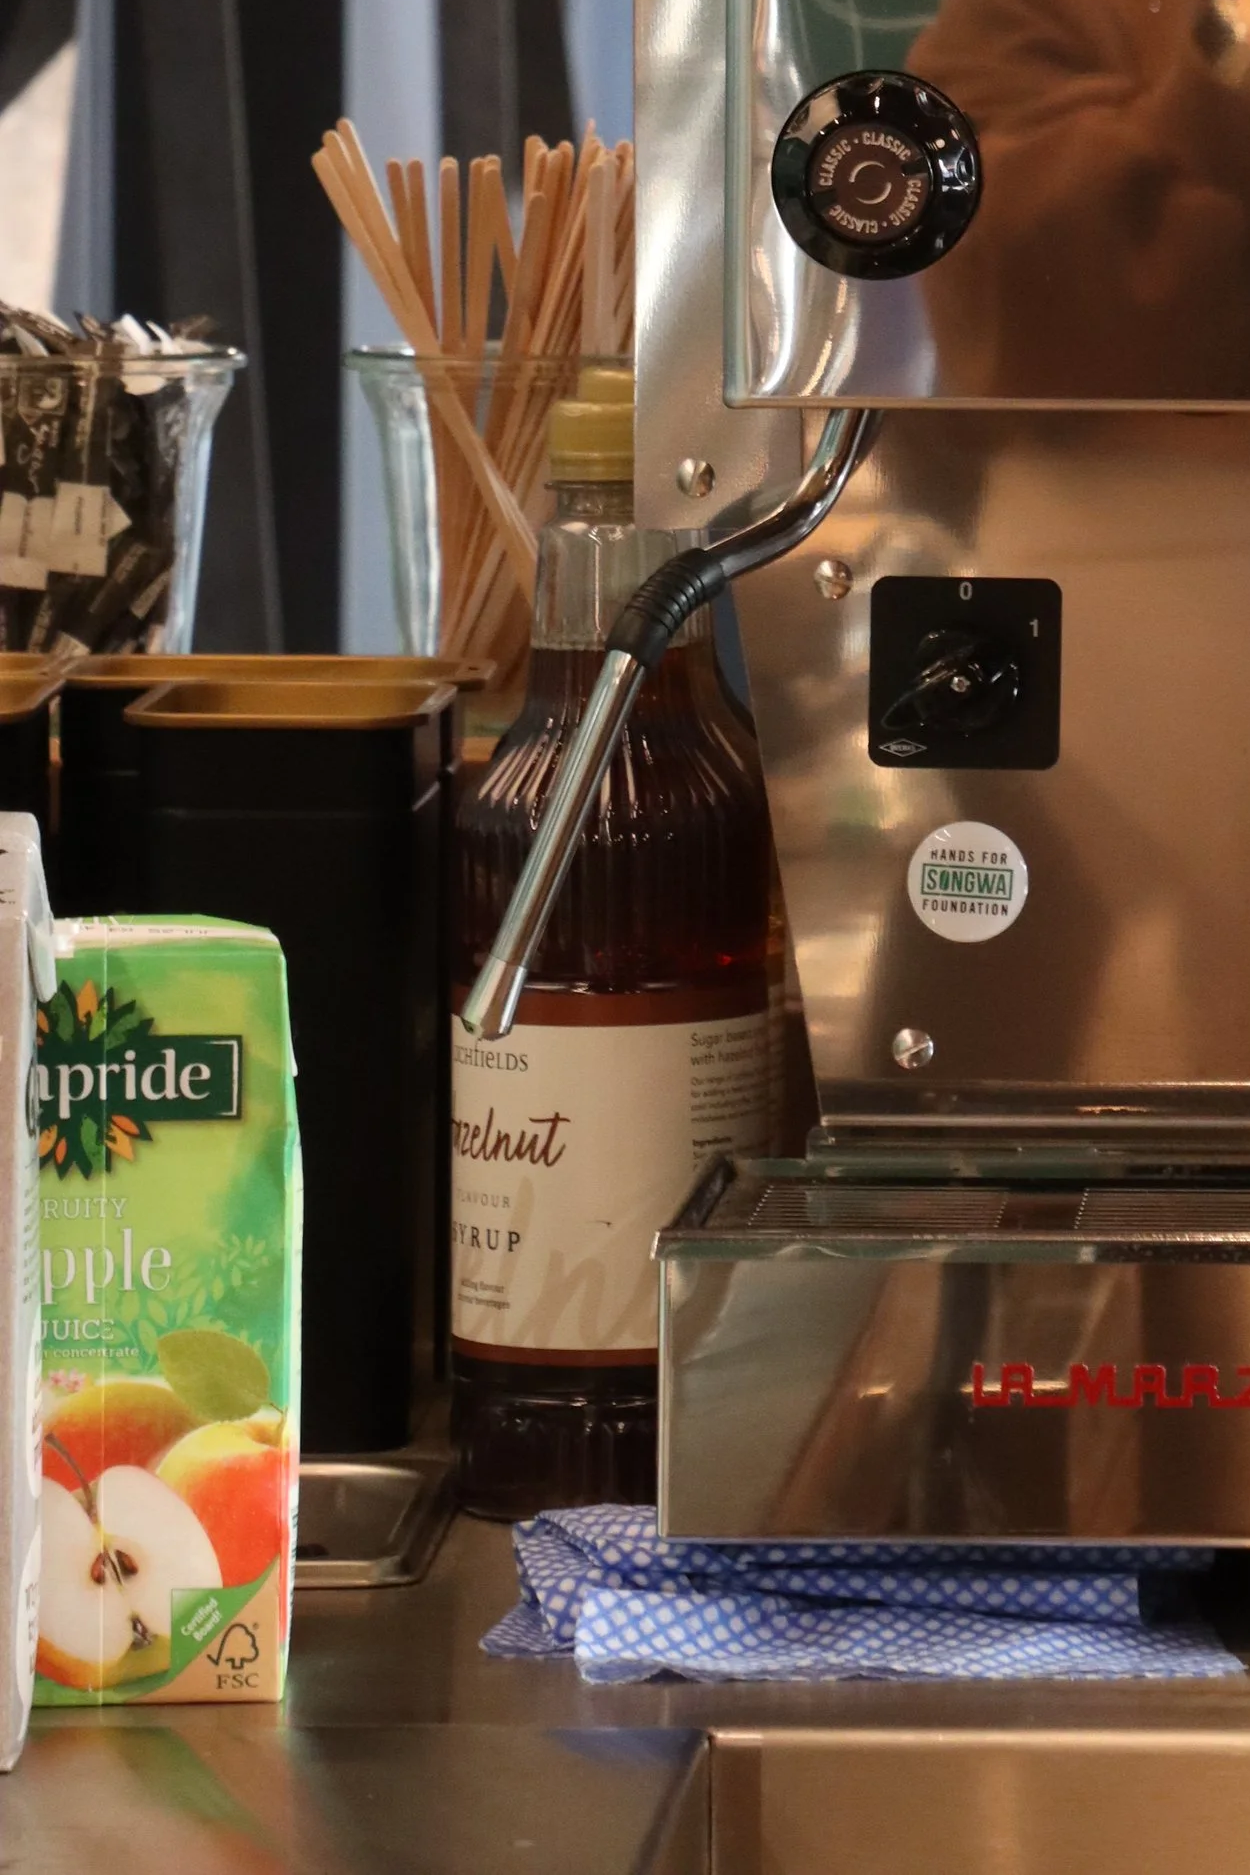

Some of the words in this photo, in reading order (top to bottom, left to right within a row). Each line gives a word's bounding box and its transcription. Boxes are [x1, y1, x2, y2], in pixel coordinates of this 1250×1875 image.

[819, 139, 851, 186] CLASSIC
[861, 131, 912, 162] CLASSIC
[889, 179, 921, 226] CLASSIC
[828, 204, 879, 235] CLASSIC
[959, 581, 973, 601] 0
[1029, 618, 1039, 638] 1
[930, 848, 975, 863] HANDS
[982, 851, 1008, 865] FOR
[926, 869, 1007, 896] SONGWA
[922, 899, 1009, 916] FOUNDATION
[40, 1197, 127, 1219] RUITY
[40, 1228, 172, 1305] pple
[41, 1318, 114, 1341] JUICE
[53, 1346, 140, 1358] concentrate
[973, 1362, 1035, 1408] LA
[216, 1672, 260, 1690] FSC
